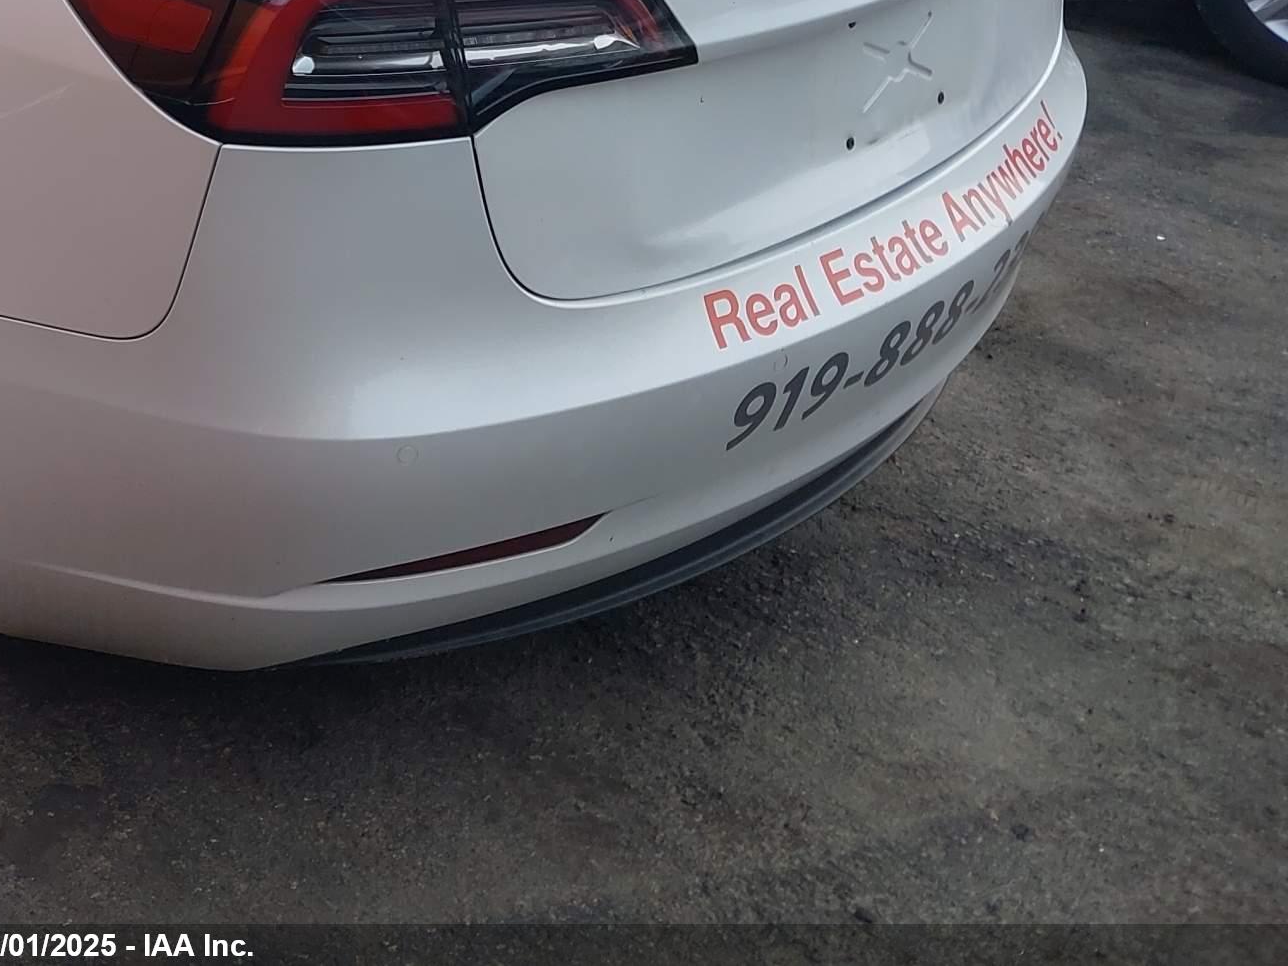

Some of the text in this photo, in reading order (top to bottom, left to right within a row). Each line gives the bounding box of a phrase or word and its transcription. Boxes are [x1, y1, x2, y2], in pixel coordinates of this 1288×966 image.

[703, 99, 1064, 351] Real Estate Anywhere!
